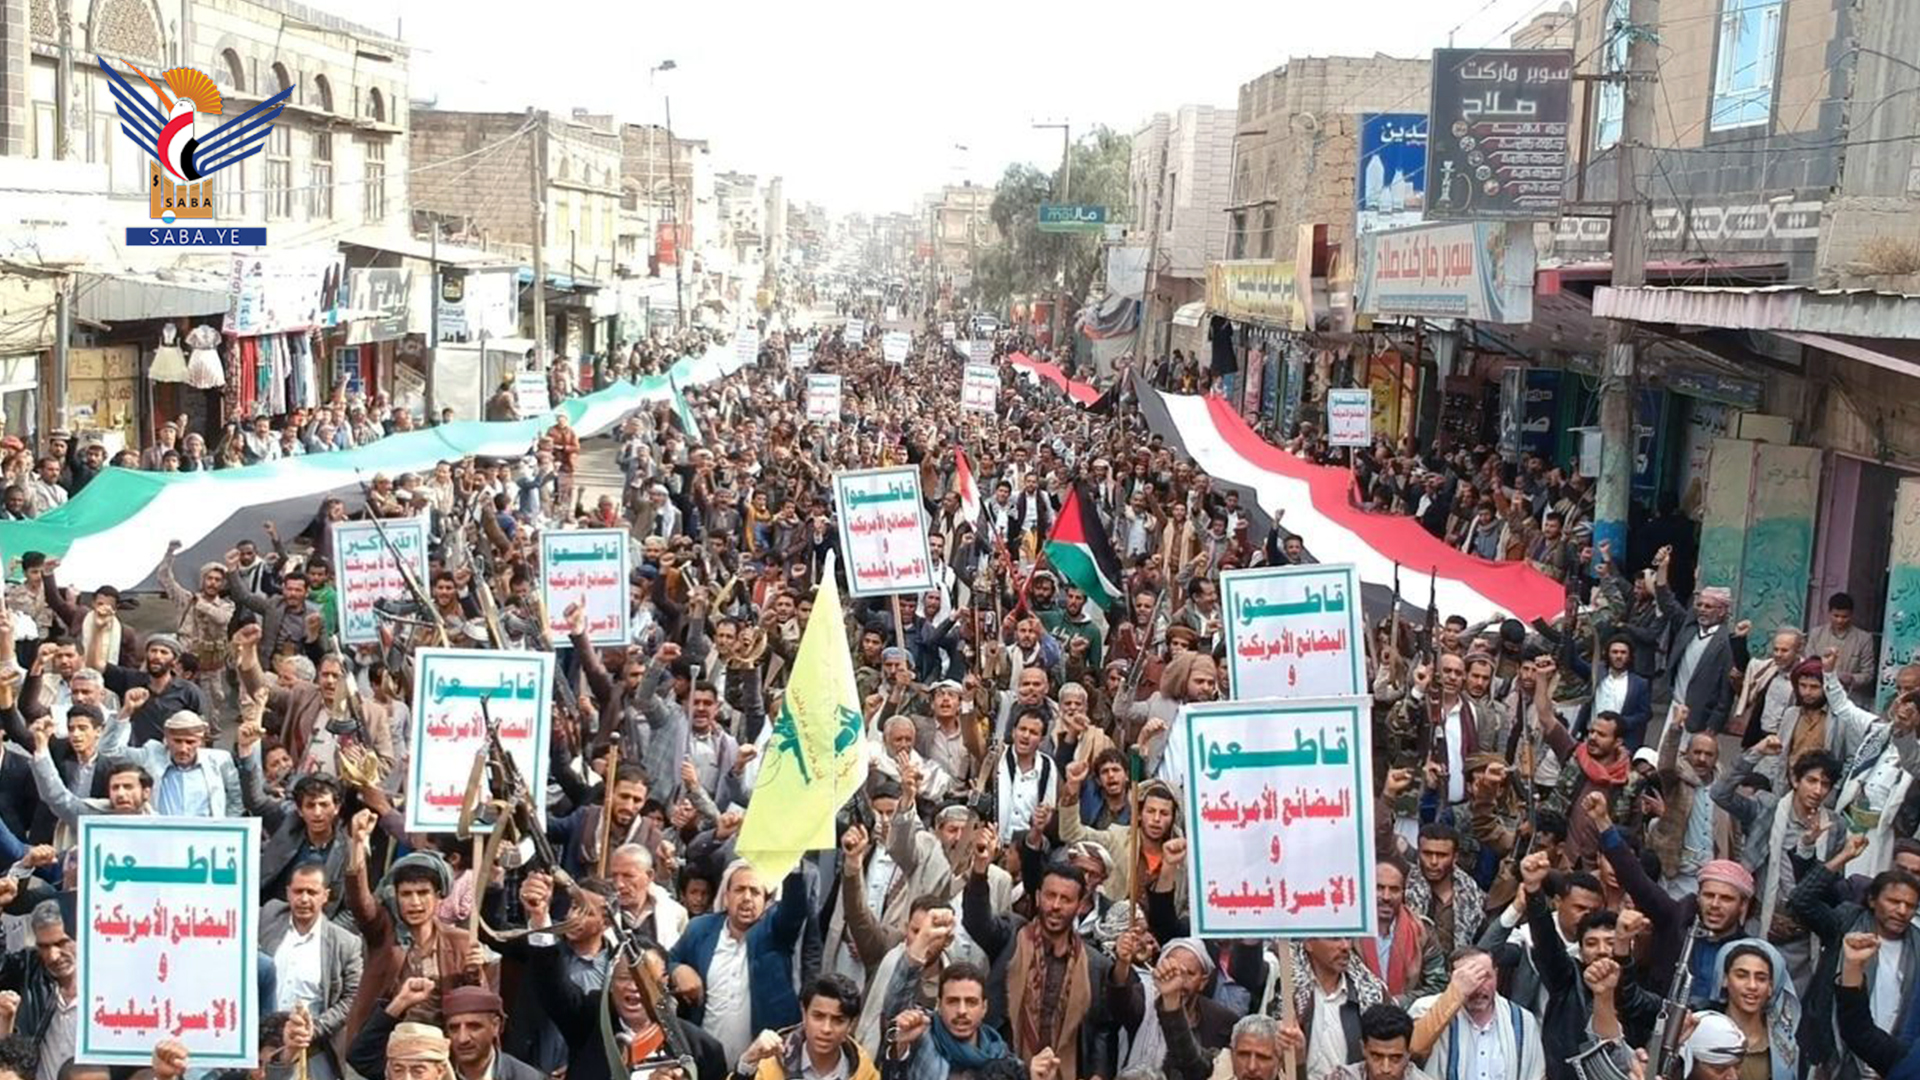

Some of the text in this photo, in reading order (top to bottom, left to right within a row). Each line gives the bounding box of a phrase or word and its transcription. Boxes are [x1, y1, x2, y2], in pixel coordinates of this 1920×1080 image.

[1461, 61, 1571, 84] سوبر ماركت
[1462, 91, 1537, 123] صلاح
[1402, 235, 1439, 287] ماركت
[1441, 242, 1473, 287] سوبر
[844, 480, 915, 510] قاطعوا
[887, 512, 919, 533] البضائع
[548, 541, 618, 567] قاطعوا
[883, 537, 889, 553] و
[856, 557, 926, 582] الإسرائيلية
[1234, 583, 1345, 626] قاطعوا
[1237, 627, 1347, 662] البضائع الأمريكية
[429, 669, 535, 704] قاطعوا
[1287, 664, 1296, 686] و
[427, 711, 483, 742] الأمريكية
[1197, 727, 1349, 780] قاطعوا
[1200, 783, 1350, 829] البضائع الأمريكية
[1269, 835, 1281, 863] و
[94, 843, 238, 892] قاطعوا
[1207, 875, 1355, 916] الإسرائيلية
[93, 899, 237, 945] البضائع الأمريكية
[157, 952, 168, 983] و
[94, 995, 237, 1038] الإسرائيلية
